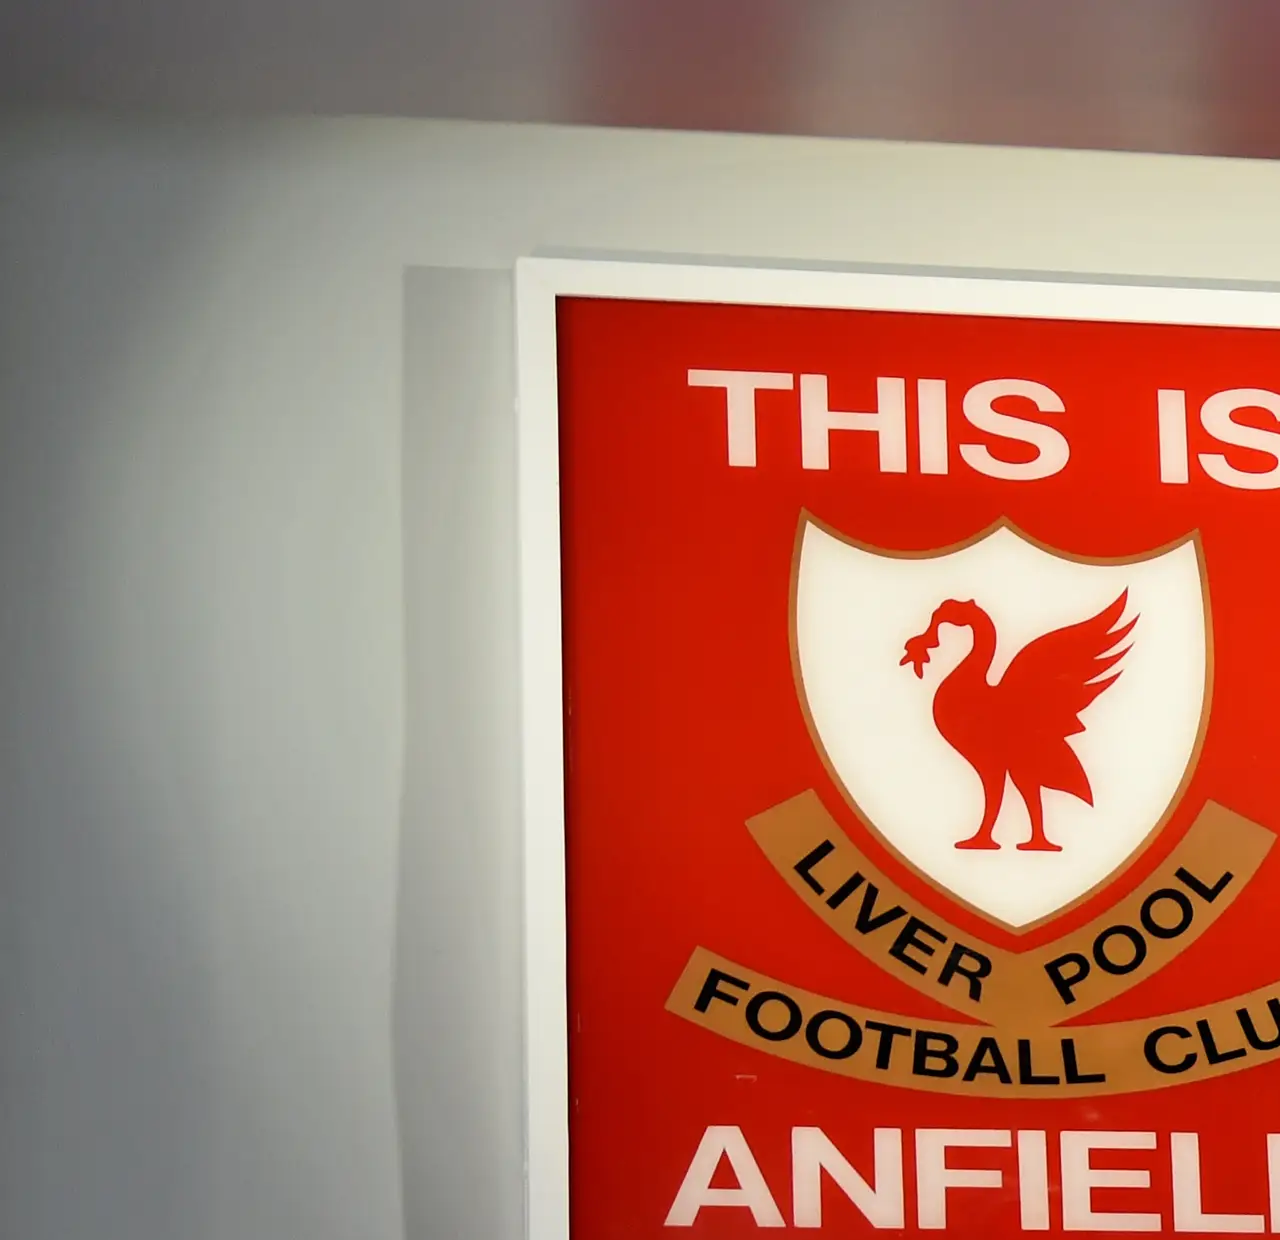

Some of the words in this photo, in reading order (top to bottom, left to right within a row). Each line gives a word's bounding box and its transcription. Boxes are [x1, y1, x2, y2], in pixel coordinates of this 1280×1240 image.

[687, 368, 1070, 481] THIS
[793, 839, 994, 1003] LIVER
[1042, 865, 1234, 1006] POOL
[693, 966, 1107, 1086] FOOTBALL
